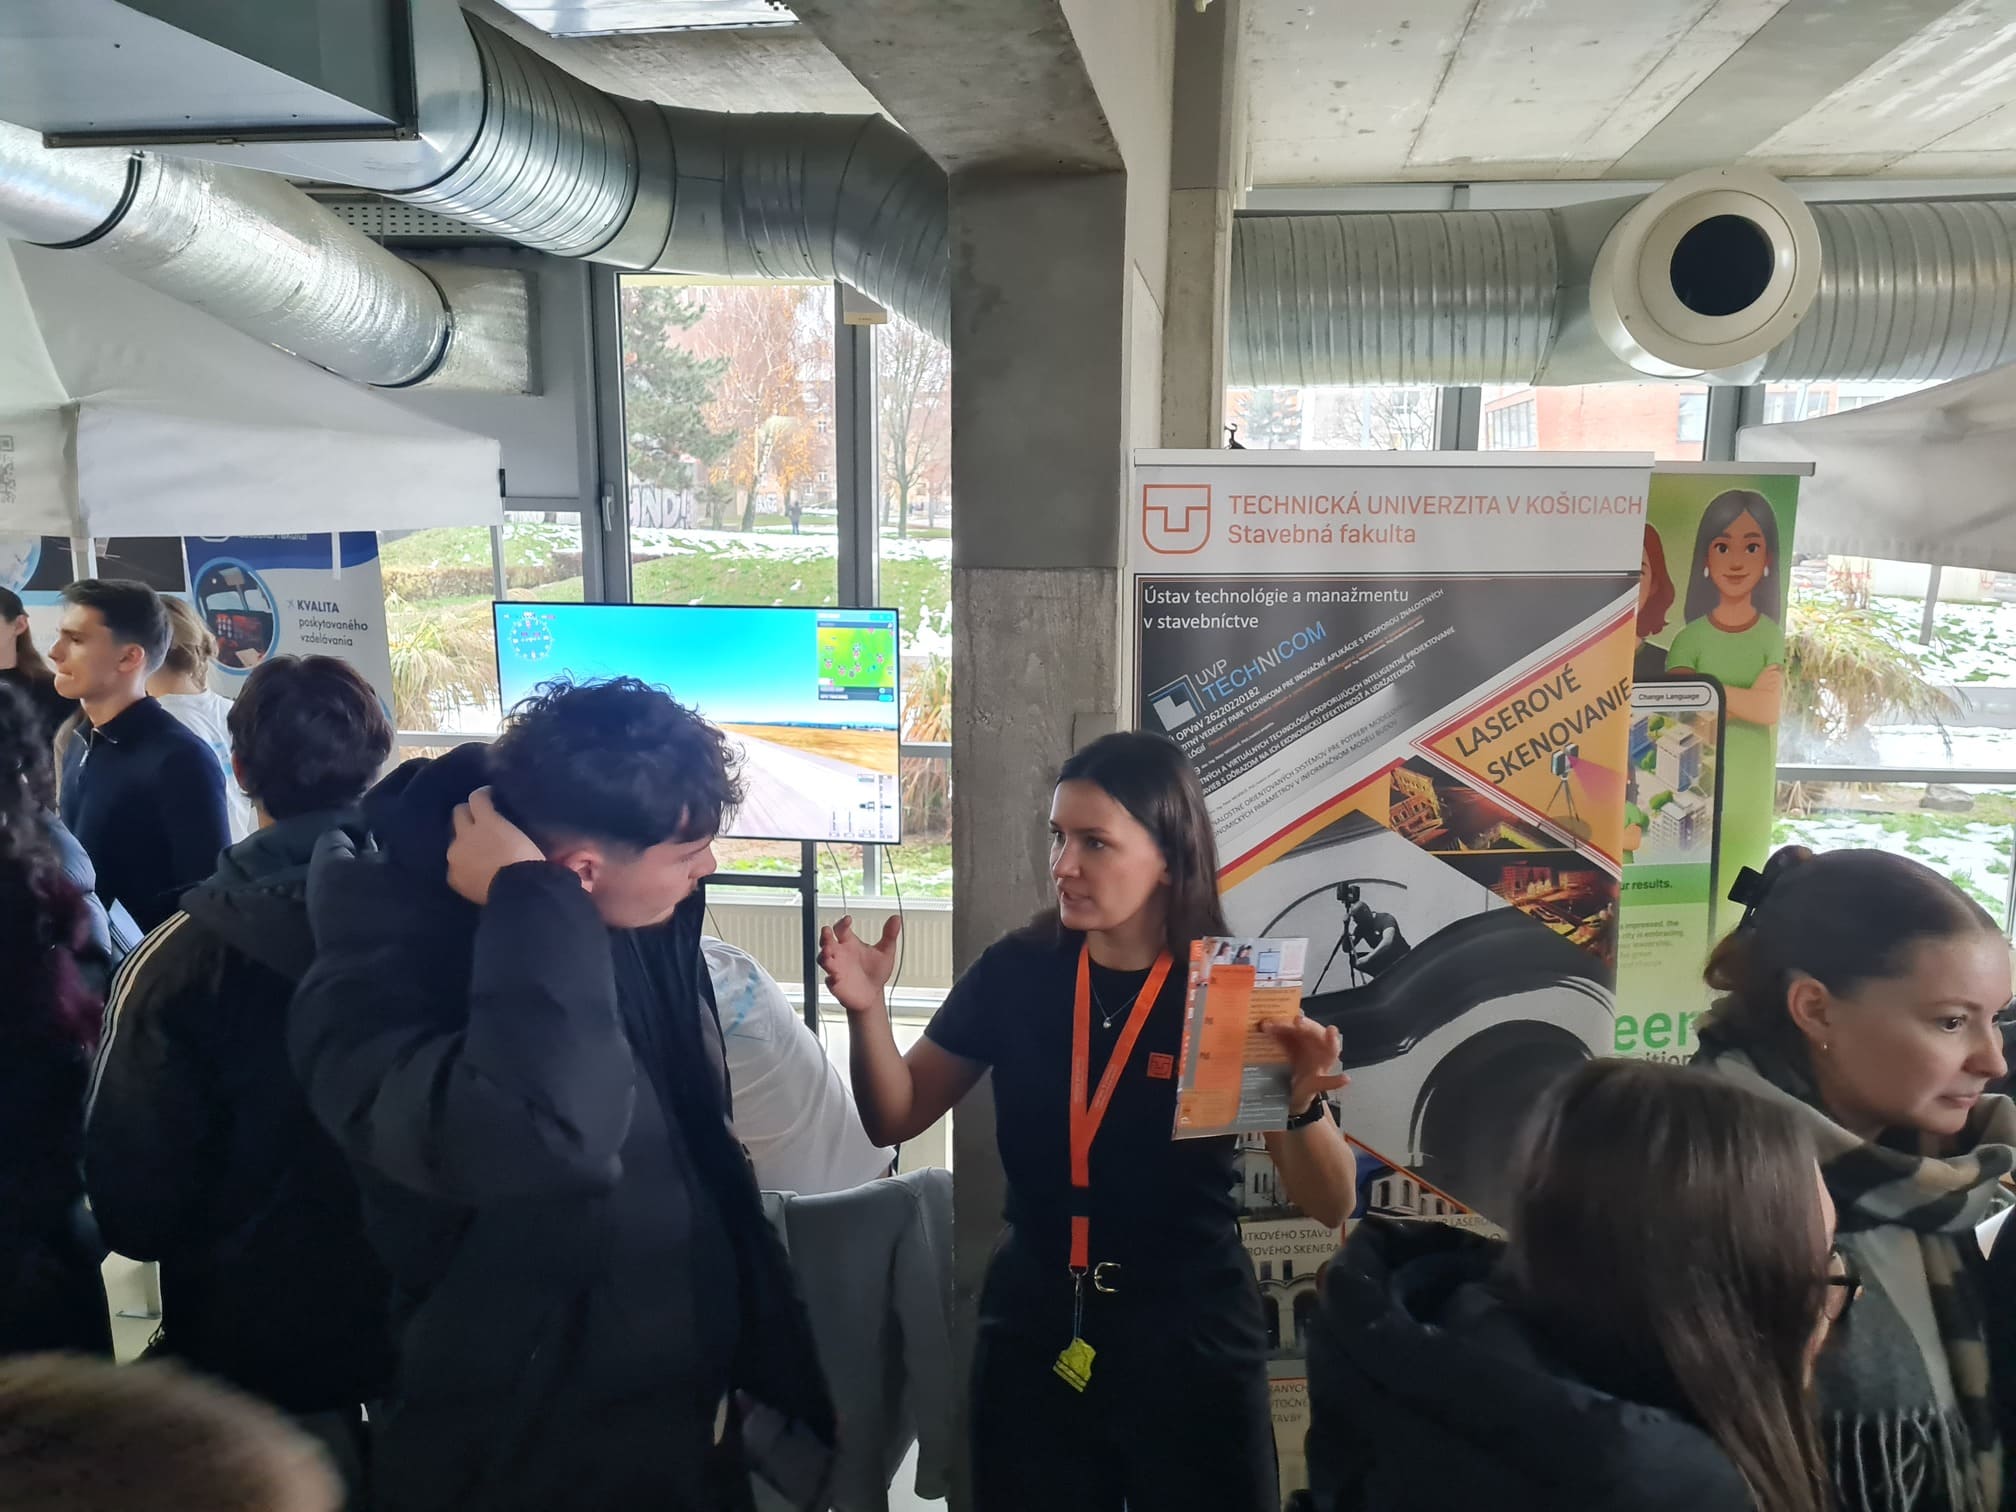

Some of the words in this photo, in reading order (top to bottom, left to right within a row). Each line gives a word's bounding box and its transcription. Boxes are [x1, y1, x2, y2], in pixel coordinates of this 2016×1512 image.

[1229, 491, 1361, 515] TECHNICKÁ
[1368, 495, 1501, 515] UNIVERZITA
[1505, 495, 1523, 515] V
[1526, 489, 1642, 515] KOŠICIACH
[1228, 524, 1333, 545] Stavebná
[1340, 524, 1417, 544] fakulta
[297, 600, 340, 614] KVALITA
[1144, 585, 1189, 604] Ústav
[1195, 587, 1288, 607] technológie
[1292, 592, 1301, 603] a
[1306, 587, 1409, 603] manažmentu
[1143, 617, 1153, 629] v
[1157, 613, 1259, 629] stavebníctve
[1195, 659, 1227, 685] UVP
[1202, 621, 1327, 702] TECHNICOM
[1203, 685, 1260, 724] 26220220182
[1639, 693, 1664, 701] Change
[1666, 693, 1700, 701] Language
[1227, 709, 1245, 722] PARK
[1456, 663, 1581, 757] LASEROVÉ
[1487, 677, 1632, 784] SKENOVANIE
[1632, 877, 1673, 890] results.
